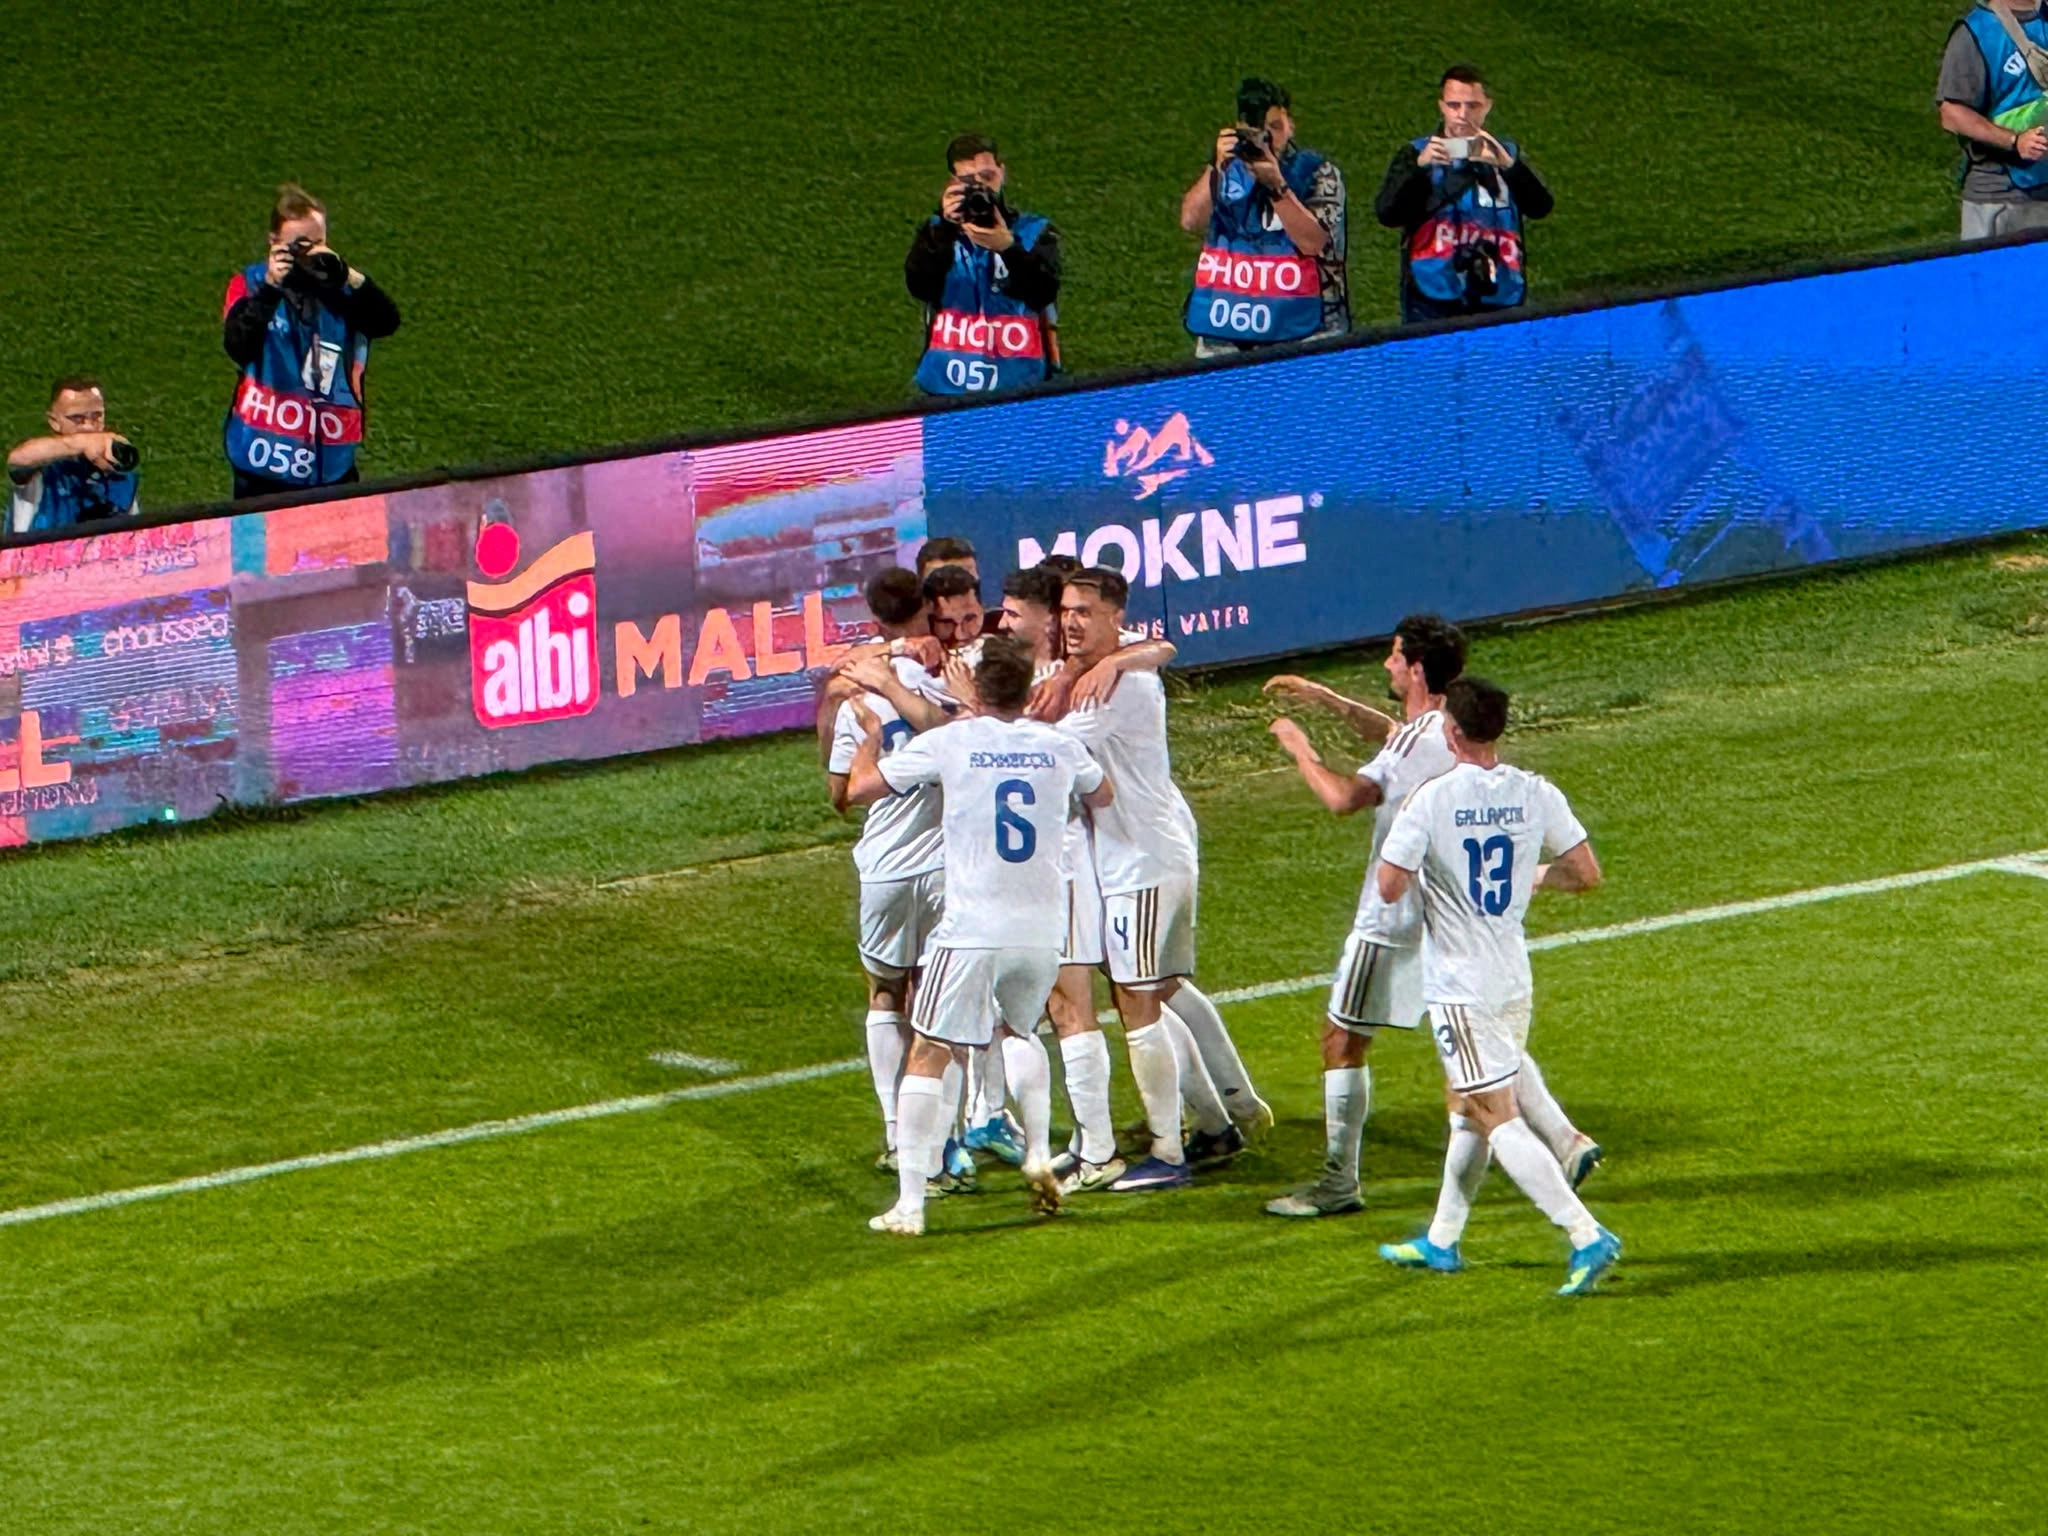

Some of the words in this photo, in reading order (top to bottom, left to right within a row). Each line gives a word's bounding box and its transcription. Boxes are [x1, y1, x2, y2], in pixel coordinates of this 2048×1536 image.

[1197, 252, 1301, 291] PHOTO
[1209, 298, 1271, 334] 060
[946, 359, 998, 391] 057
[248, 437, 316, 478] 058
[1018, 495, 1307, 588] MOKNE
[483, 592, 590, 717] albi
[614, 590, 854, 697] MALL
[995, 779, 1036, 863] 6
[1463, 834, 1514, 917] 13
[1113, 916, 1129, 950] 4
